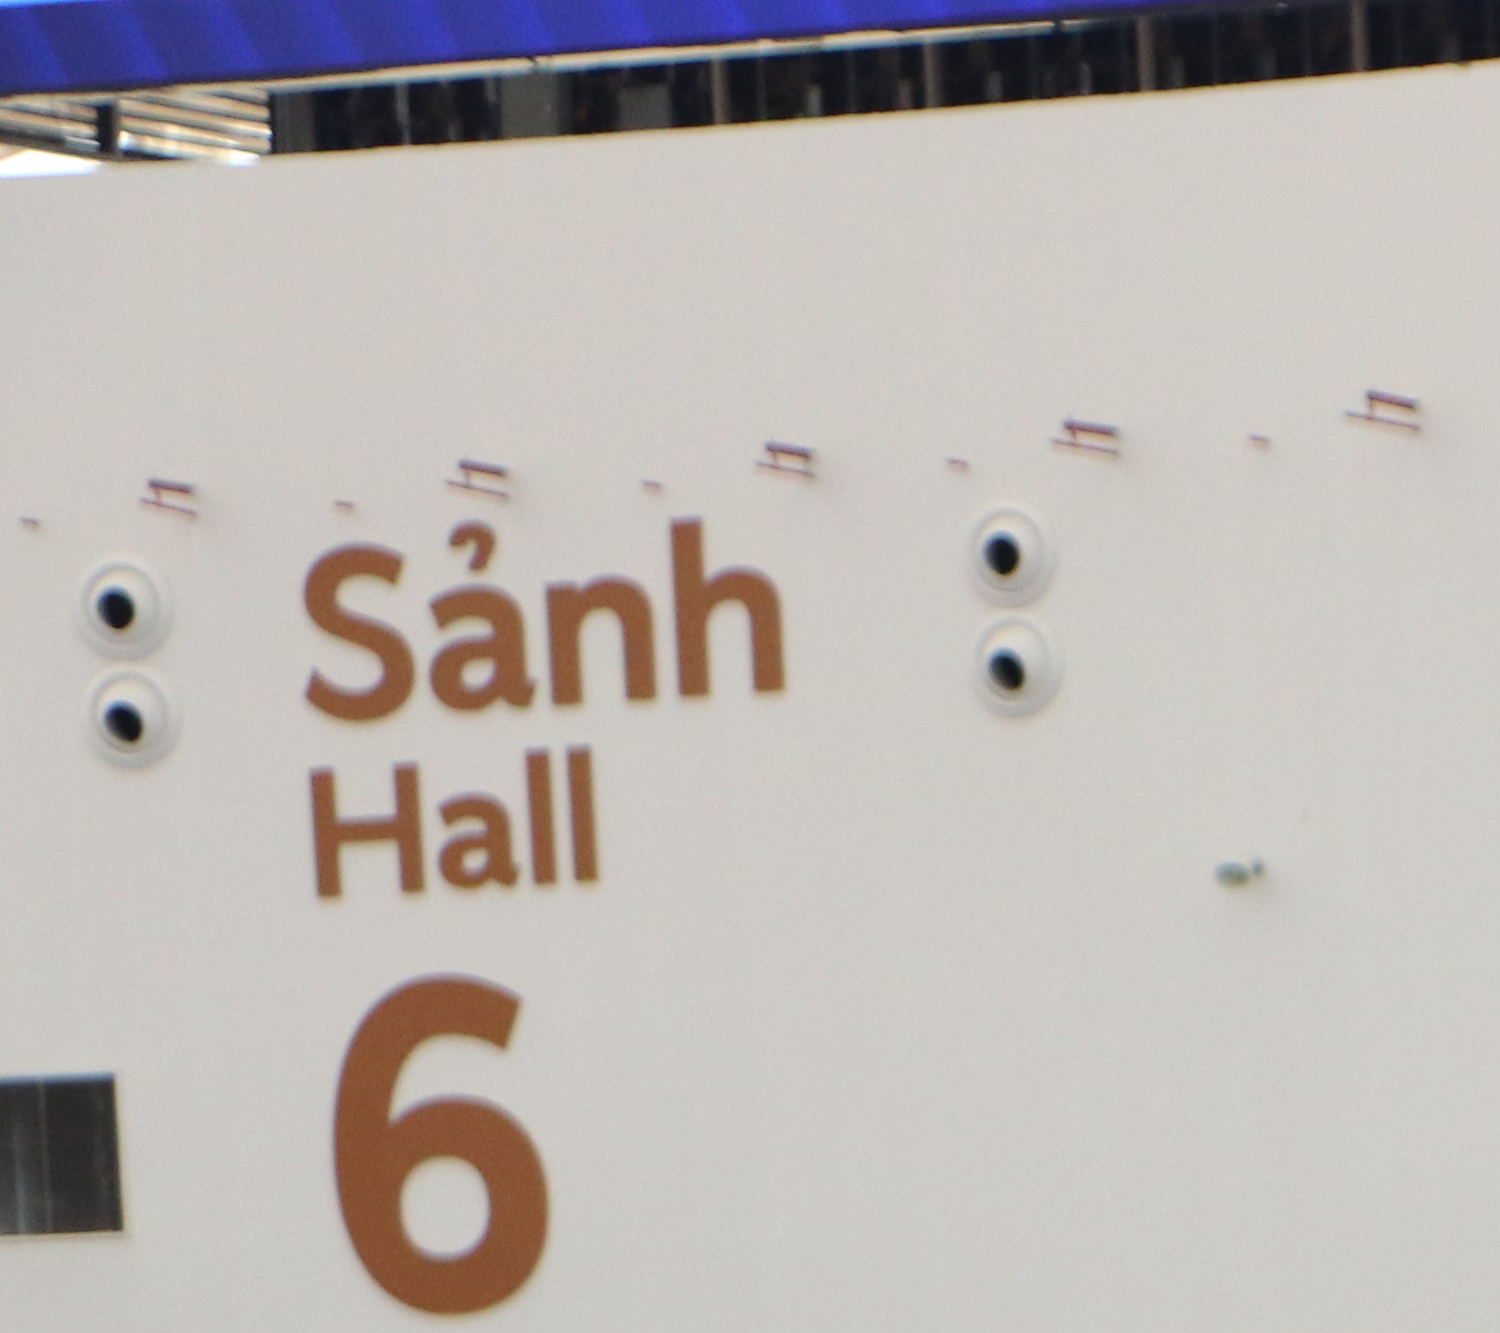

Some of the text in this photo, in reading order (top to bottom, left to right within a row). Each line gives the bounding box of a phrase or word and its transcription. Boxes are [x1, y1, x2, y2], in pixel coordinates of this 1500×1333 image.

[302, 517, 786, 723] Sảnh
[307, 745, 600, 901] Hall
[333, 972, 549, 1316] 6
